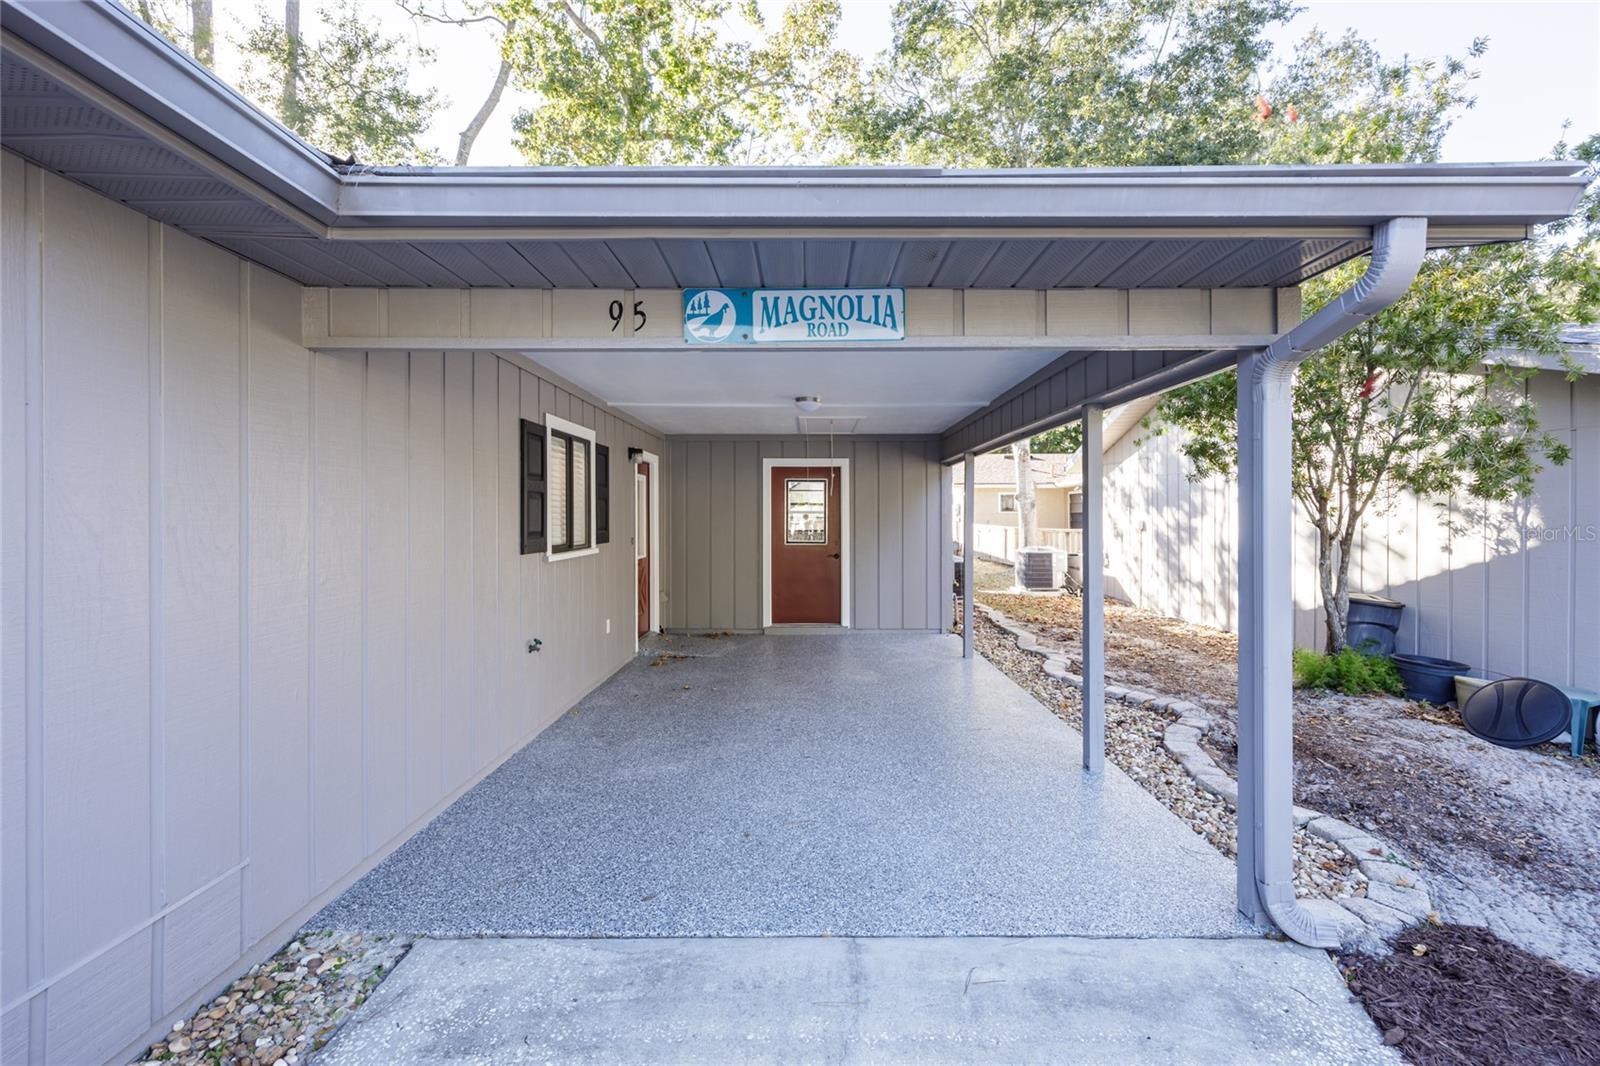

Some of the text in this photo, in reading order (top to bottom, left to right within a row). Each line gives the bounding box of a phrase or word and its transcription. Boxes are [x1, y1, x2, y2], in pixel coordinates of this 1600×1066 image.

[609, 300, 647, 332] 95
[759, 294, 899, 333] MAGNOLIA
[807, 322, 849, 337] ROAD
